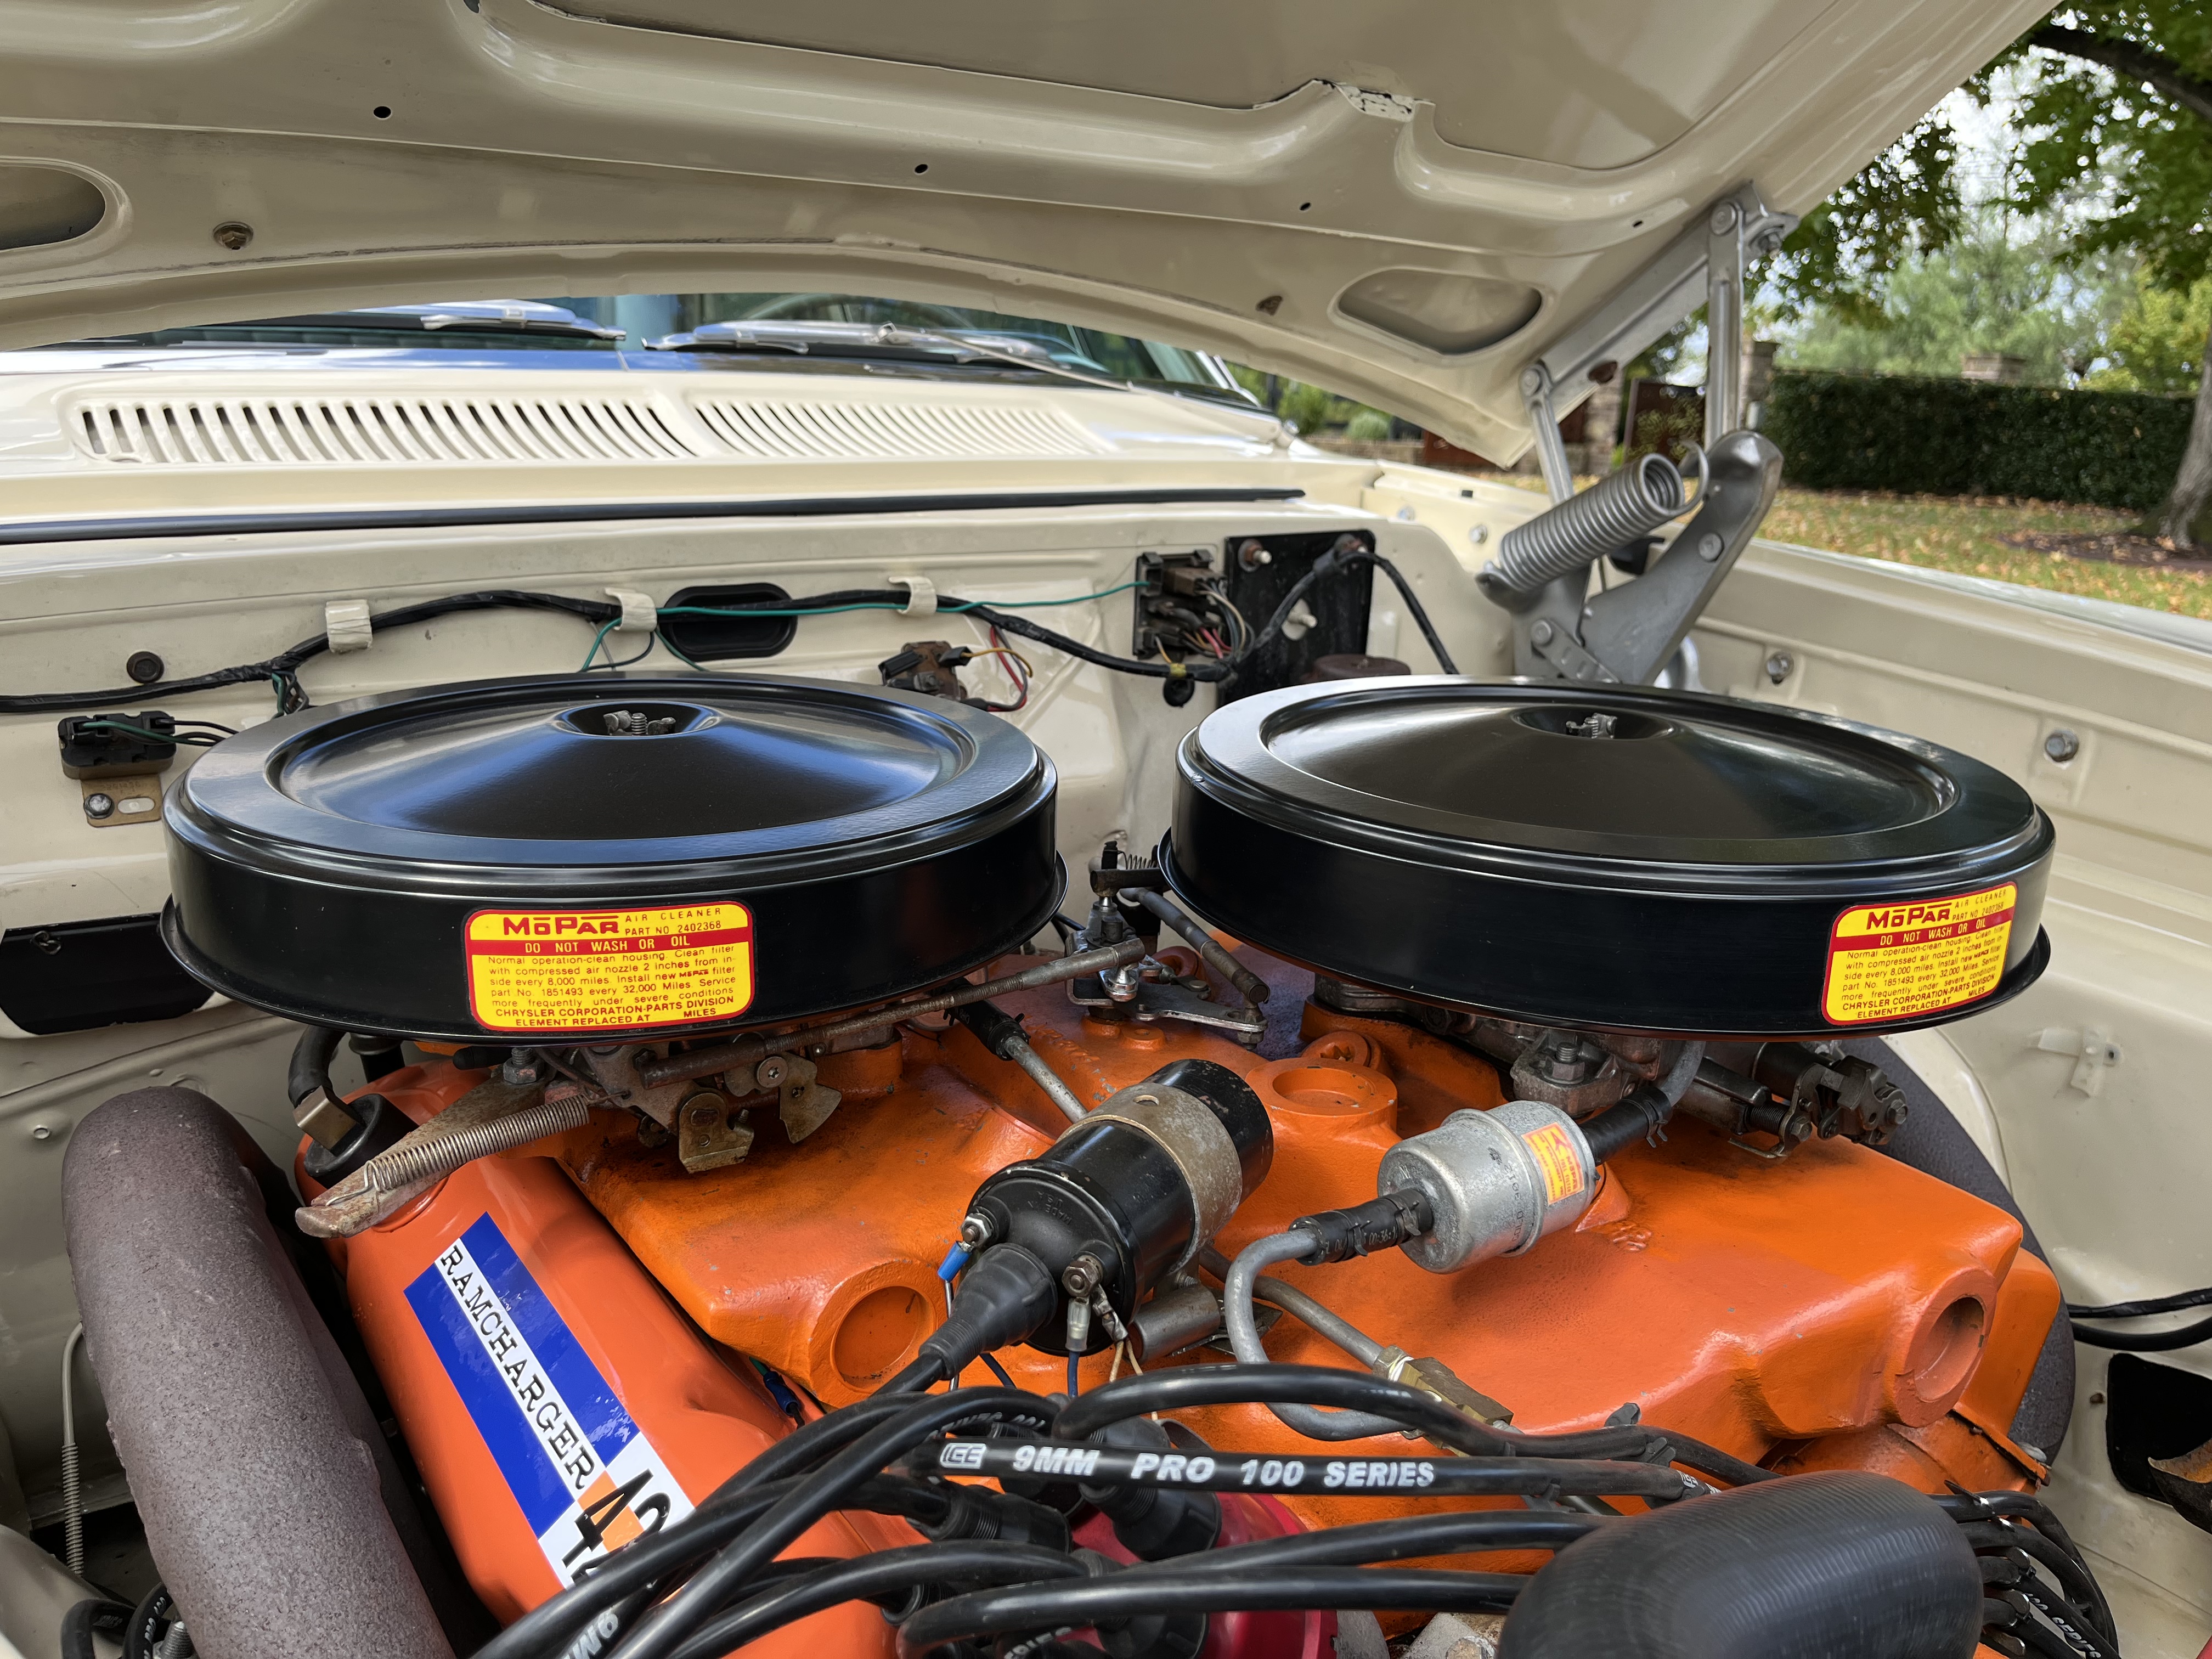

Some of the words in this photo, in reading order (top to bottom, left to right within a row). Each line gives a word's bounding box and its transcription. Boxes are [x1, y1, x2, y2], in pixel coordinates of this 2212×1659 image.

[1955, 900, 1968, 909] AIR
[1976, 889, 2006, 904] CLEANER
[625, 914, 648, 922] AIR
[661, 907, 721, 920] CLEANER
[1953, 912, 1967, 921] PART
[656, 926, 669, 934] NO
[678, 921, 721, 933] 2402368
[1880, 935, 1892, 945] DO
[1903, 932, 1921, 943] NOT
[1928, 927, 1952, 939] WASH
[1958, 923, 1967, 934] OR
[1976, 918, 1985, 929] OIL
[525, 943, 540, 953] DO
[555, 942, 579, 952] NOT
[591, 940, 628, 952] WASH
[639, 939, 654, 949] OR
[671, 935, 690, 946] OIL
[1848, 950, 1878, 958] Normal
[1883, 942, 1942, 956] operation-clean
[1976, 930, 1990, 939] Clean
[1868, 956, 1916, 969] compressed
[1933, 950, 1953, 958] nozzle
[1963, 943, 1981, 952] inches
[1984, 938, 1995, 946] from
[516, 967, 580, 976] compressed
[586, 966, 600, 974] air
[606, 964, 638, 973] nozzle
[656, 961, 690, 970] inches
[532, 955, 616, 966] operation-clean
[1891, 966, 1910, 976] 8,000
[1938, 958, 1958, 968] Install
[1990, 945, 2001, 953] filter
[548, 978, 575, 986] 8,000
[618, 974, 650, 983] Install
[713, 966, 736, 974] filter
[1843, 983, 1859, 991] part
[1884, 975, 1914, 986] 1851493
[1918, 973, 1936, 981] every
[1940, 967, 1960, 978] 32,000
[1982, 955, 1999, 966] Service
[1872, 987, 1911, 998] frequently
[1918, 983, 1939, 991] under
[1944, 977, 1964, 986] severe
[1970, 965, 1996, 979] conditions
[541, 988, 583, 996] 1851493
[589, 987, 617, 995] every
[623, 984, 656, 994] 32,000
[699, 976, 736, 986] Service
[1843, 999, 1889, 1010] CHRYSLER
[1972, 973, 1995, 988] DIVISION
[529, 999, 582, 1008] frequently
[593, 996, 623, 1005] under
[634, 995, 669, 1003] severe
[679, 988, 733, 999] conditions
[560, 1002, 682, 1017] CORPORATION-PARTS
[687, 996, 733, 1008] DIVISION
[1858, 1007, 1898, 1018] ELEMENT
[1900, 999, 1940, 1013] REPLACED
[1968, 986, 1985, 997] MILES
[572, 1015, 632, 1025] REPLACED
[684, 1008, 716, 1018] MILES
[441, 1245, 596, 1490] RAMCHARGER
[1013, 1445, 1101, 1476] 9MM
[1130, 1452, 1216, 1483] PRO
[1240, 1459, 1305, 1487] 100
[1323, 1461, 1435, 1487] SERIES
